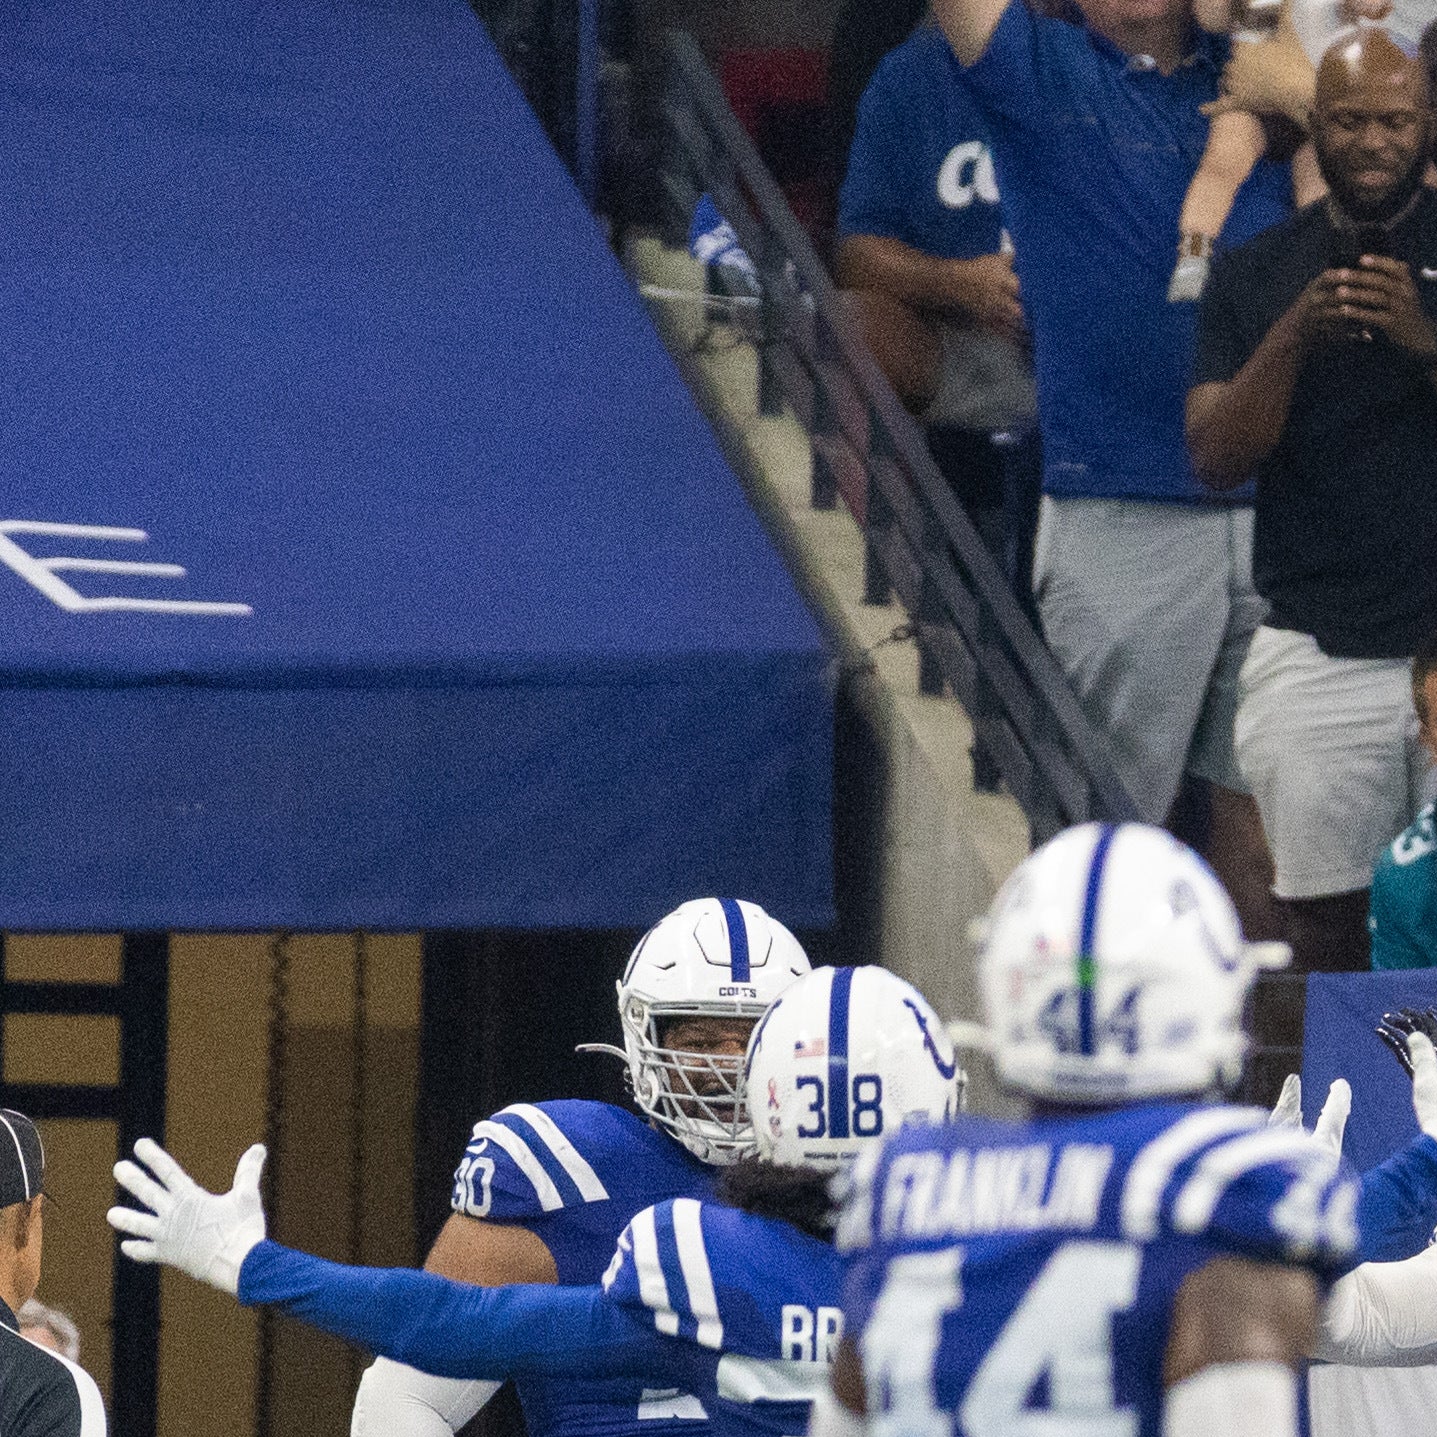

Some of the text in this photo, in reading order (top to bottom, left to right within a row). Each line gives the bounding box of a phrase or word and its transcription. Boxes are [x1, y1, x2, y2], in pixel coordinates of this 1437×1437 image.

[719, 987, 757, 998] COLTS
[796, 1073, 884, 1139] 38
[451, 1157, 495, 1218] 90
[884, 1144, 1113, 1237] FRANKLIN
